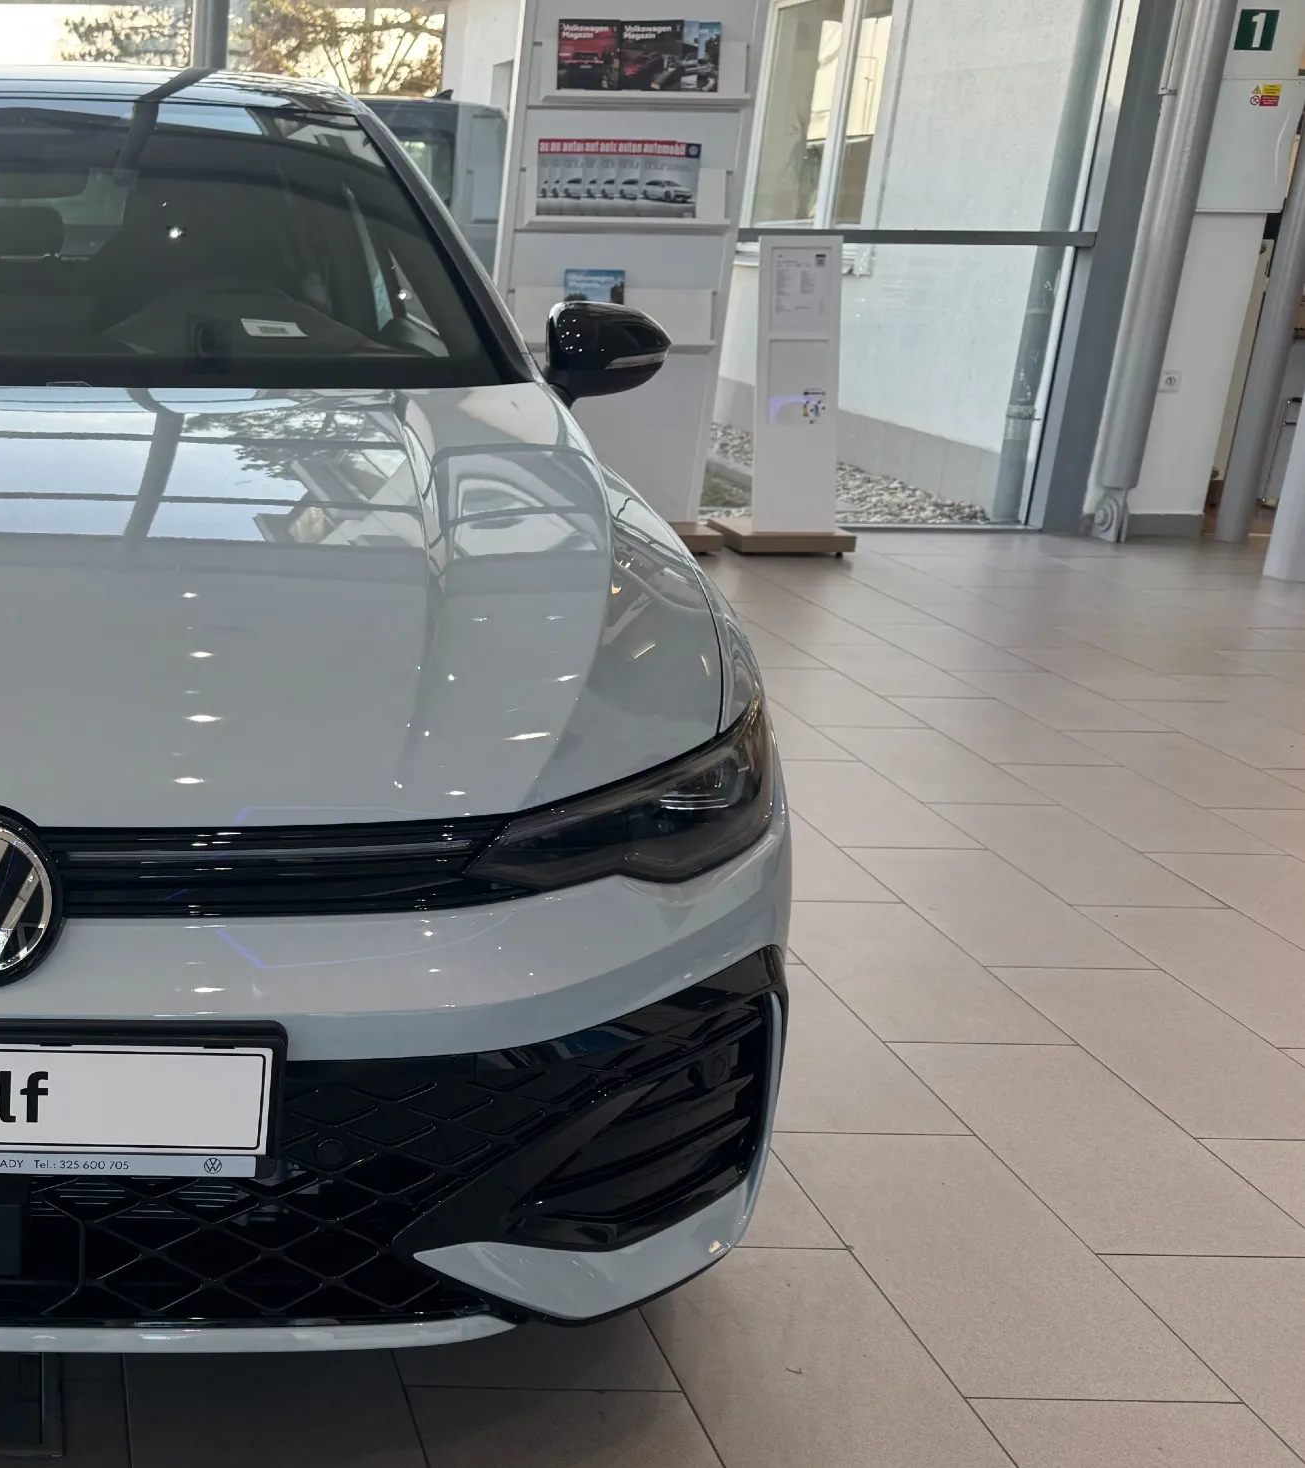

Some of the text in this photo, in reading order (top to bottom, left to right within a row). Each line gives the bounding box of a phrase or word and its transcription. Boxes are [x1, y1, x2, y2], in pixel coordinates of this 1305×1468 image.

[562, 23, 610, 34] Volkswagen
[624, 24, 672, 35] Volkswagen
[1251, 12, 1267, 48] 1
[562, 31, 594, 40] Magazin
[623, 32, 656, 41] Magazin
[34, 1159, 57, 1170] Tel.:
[59, 1160, 80, 1170] 325
[83, 1160, 106, 1170] 600
[109, 1160, 130, 1171] 705
